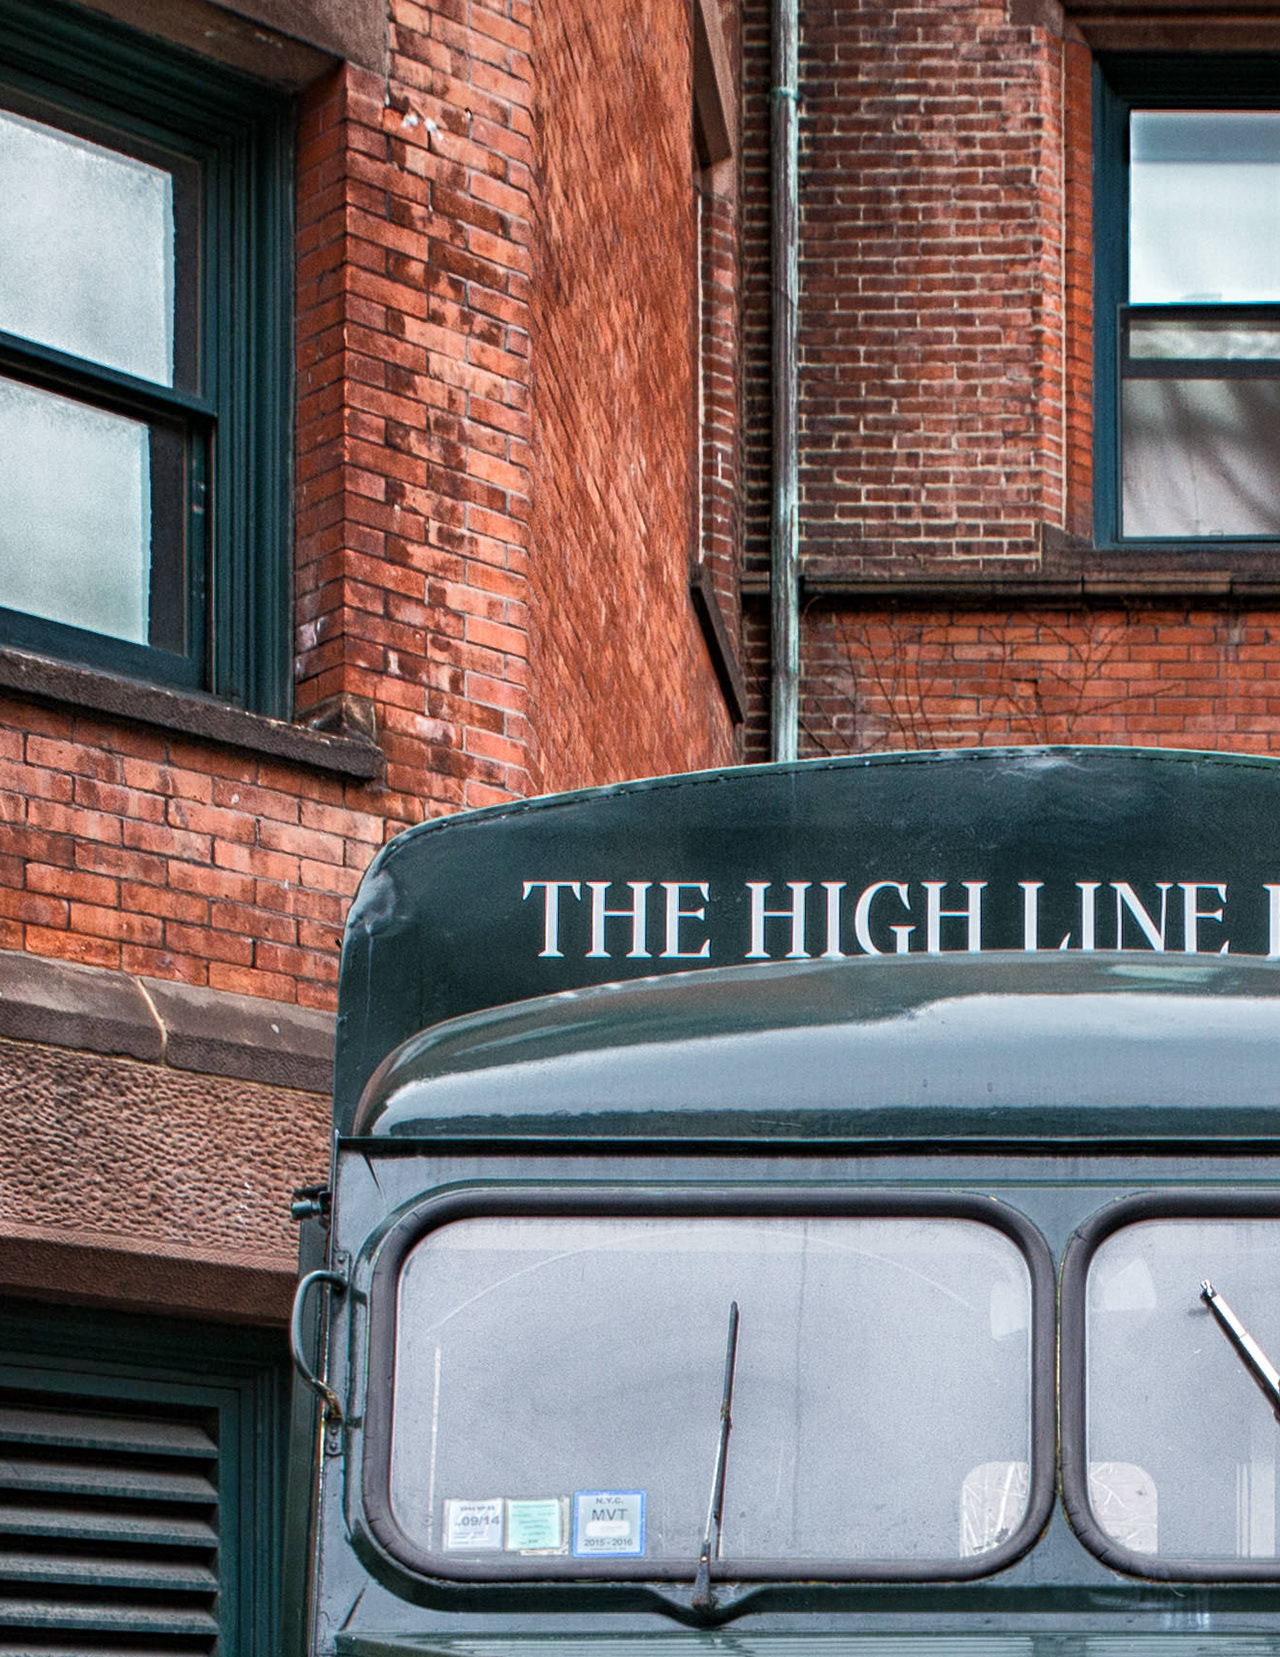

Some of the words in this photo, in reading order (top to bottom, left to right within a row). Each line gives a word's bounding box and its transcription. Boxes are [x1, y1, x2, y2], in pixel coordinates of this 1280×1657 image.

[523, 881, 711, 958] THE
[745, 881, 987, 957] HIGH
[1018, 882, 1230, 953] LINE
[592, 1508, 628, 1521] MVT
